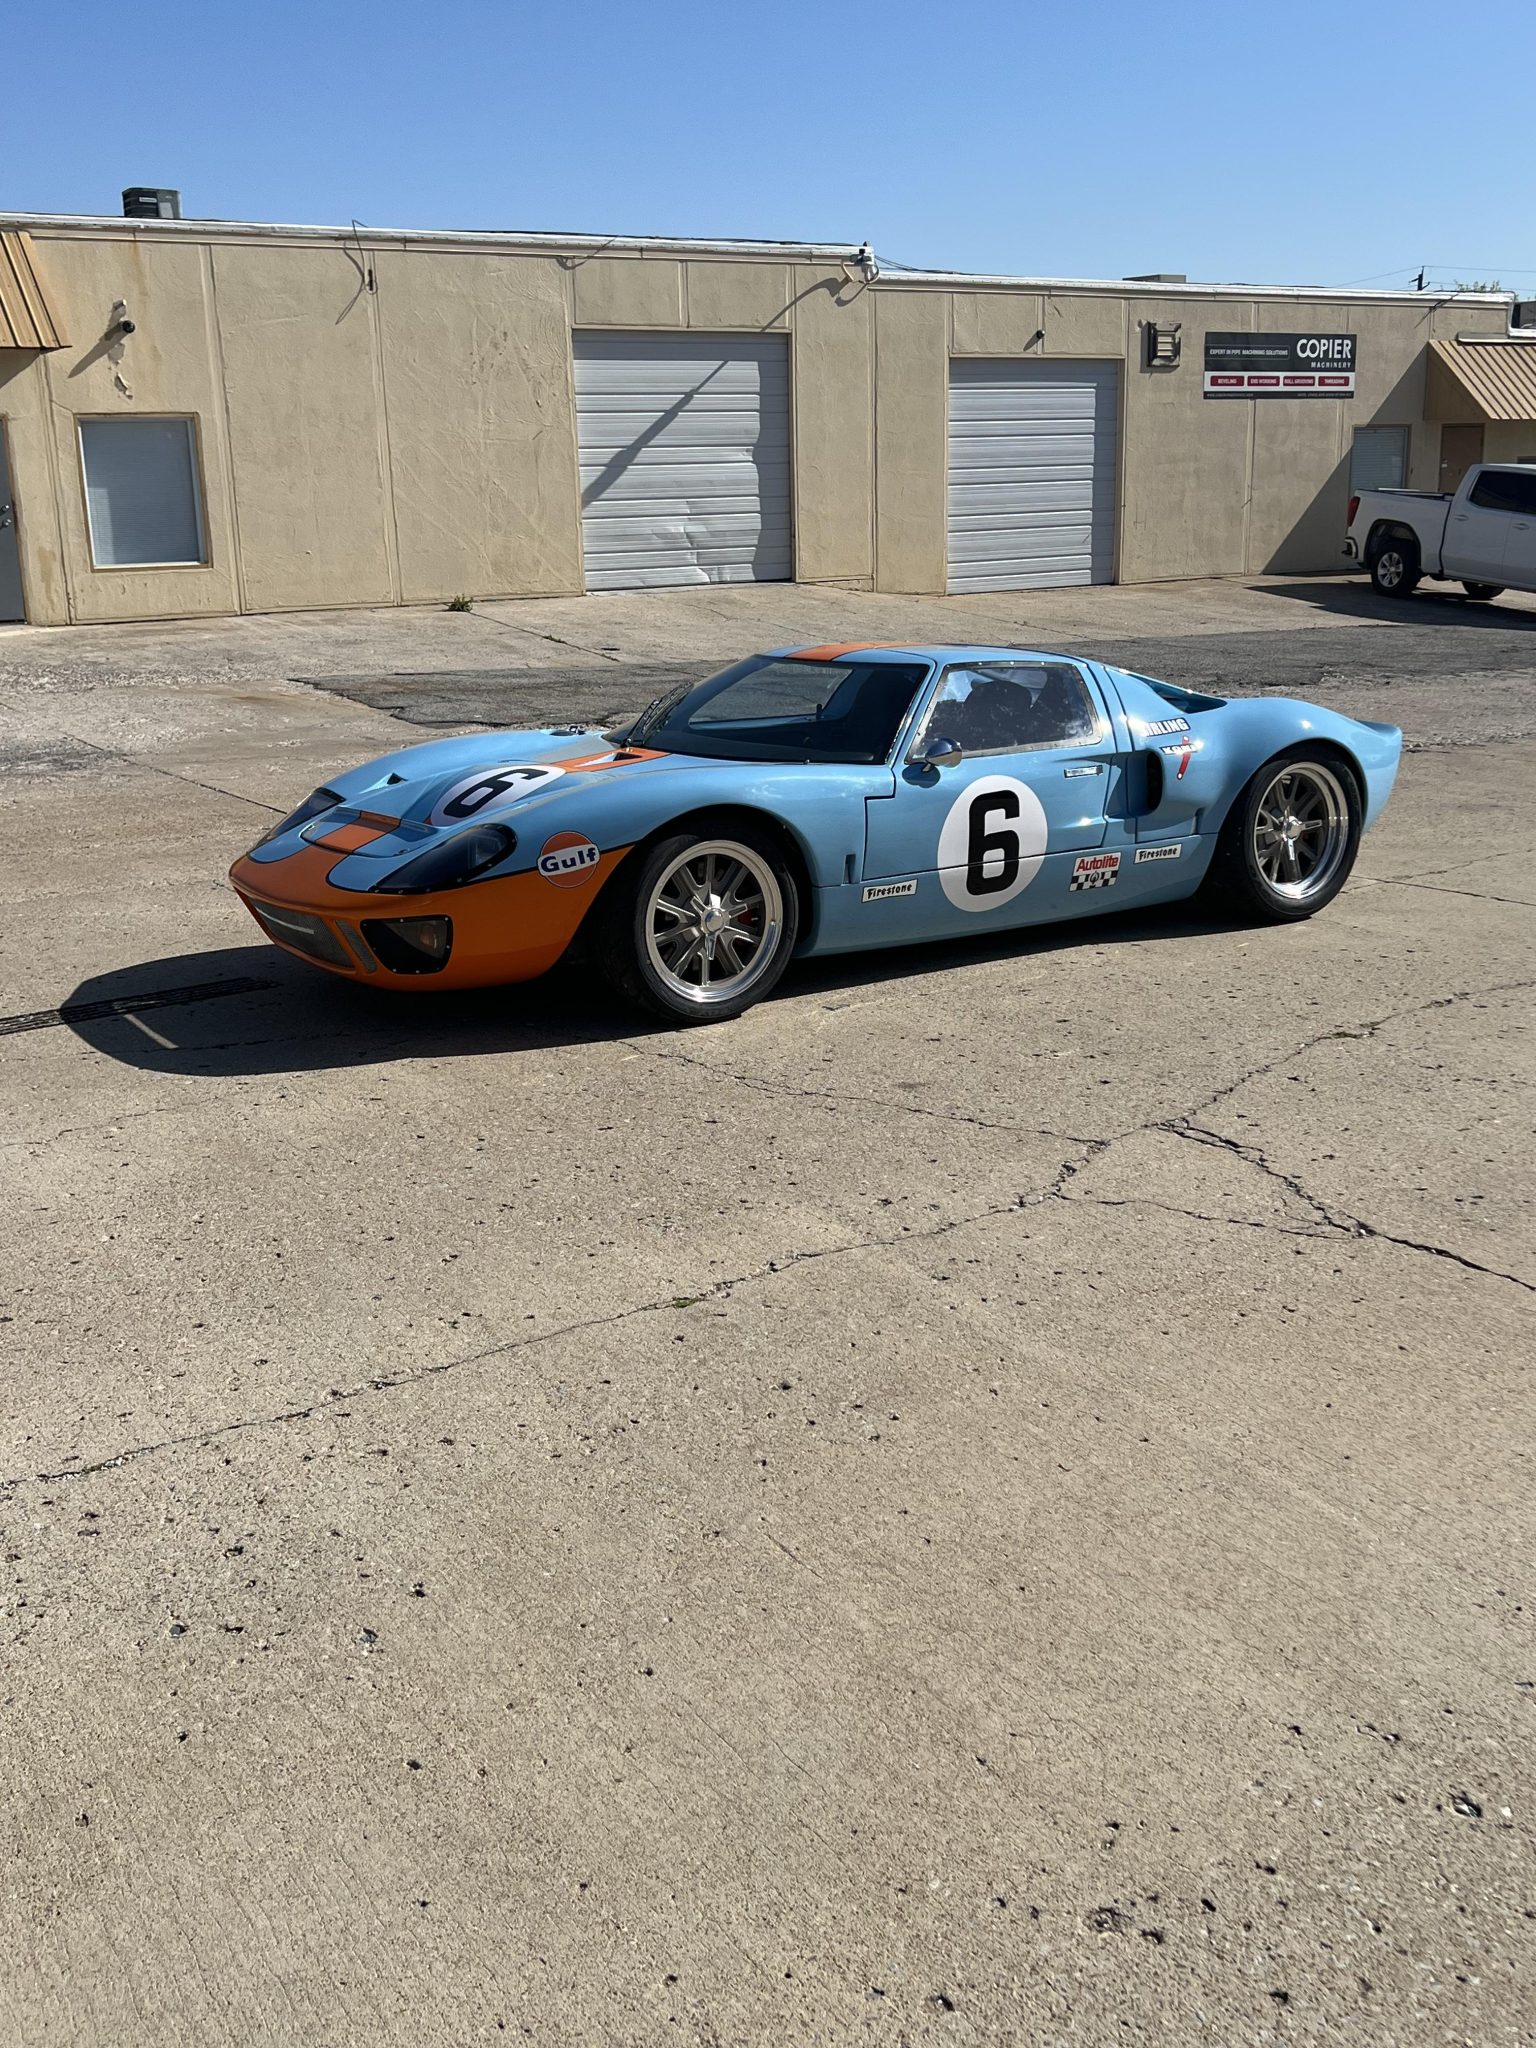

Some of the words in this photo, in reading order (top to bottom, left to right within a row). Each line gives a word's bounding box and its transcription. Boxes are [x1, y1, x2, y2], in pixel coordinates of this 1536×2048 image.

[1297, 339, 1352, 359] COPIER
[443, 768, 549, 819] 6
[966, 789, 1020, 896] 6
[540, 847, 596, 873] Gulf
[1076, 855, 1119, 872] Autolite
[1139, 847, 1178, 861] Firestone
[867, 884, 913, 900] Firestone
